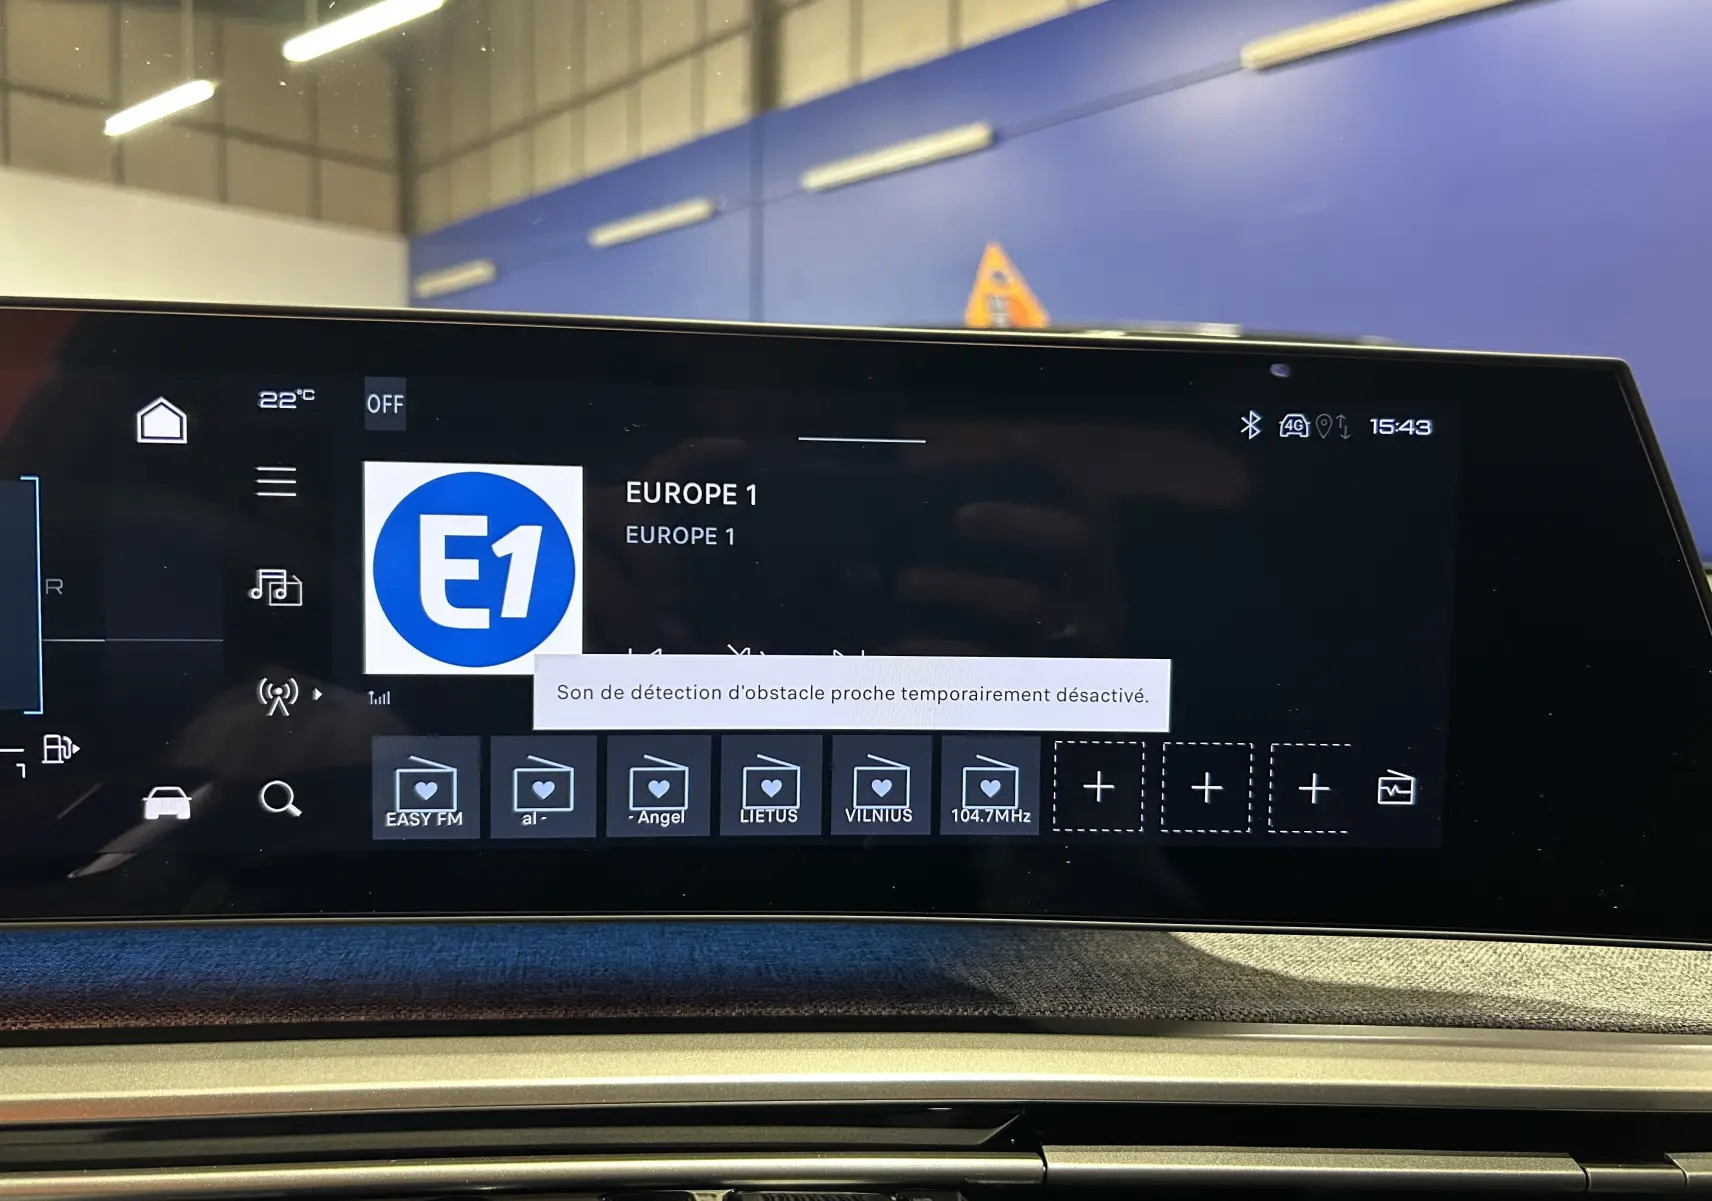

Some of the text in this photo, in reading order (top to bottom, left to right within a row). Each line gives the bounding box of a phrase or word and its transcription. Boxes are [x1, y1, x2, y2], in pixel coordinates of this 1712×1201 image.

[366, 394, 404, 415] OFF
[1284, 417, 1304, 434] 4G
[1369, 417, 1433, 436] 15:43
[626, 481, 758, 506] EUROPE 1
[625, 525, 736, 546] EUROPE 1
[419, 513, 543, 630] E1
[557, 684, 1150, 706] Son de détection d'obstacle proche temporairement désactivé.
[386, 812, 463, 827] EASY FM
[638, 808, 686, 828] Angel
[740, 808, 798, 824] LIETUS
[845, 808, 913, 824] VILNIUS
[951, 808, 1031, 824] 104.7MHz
